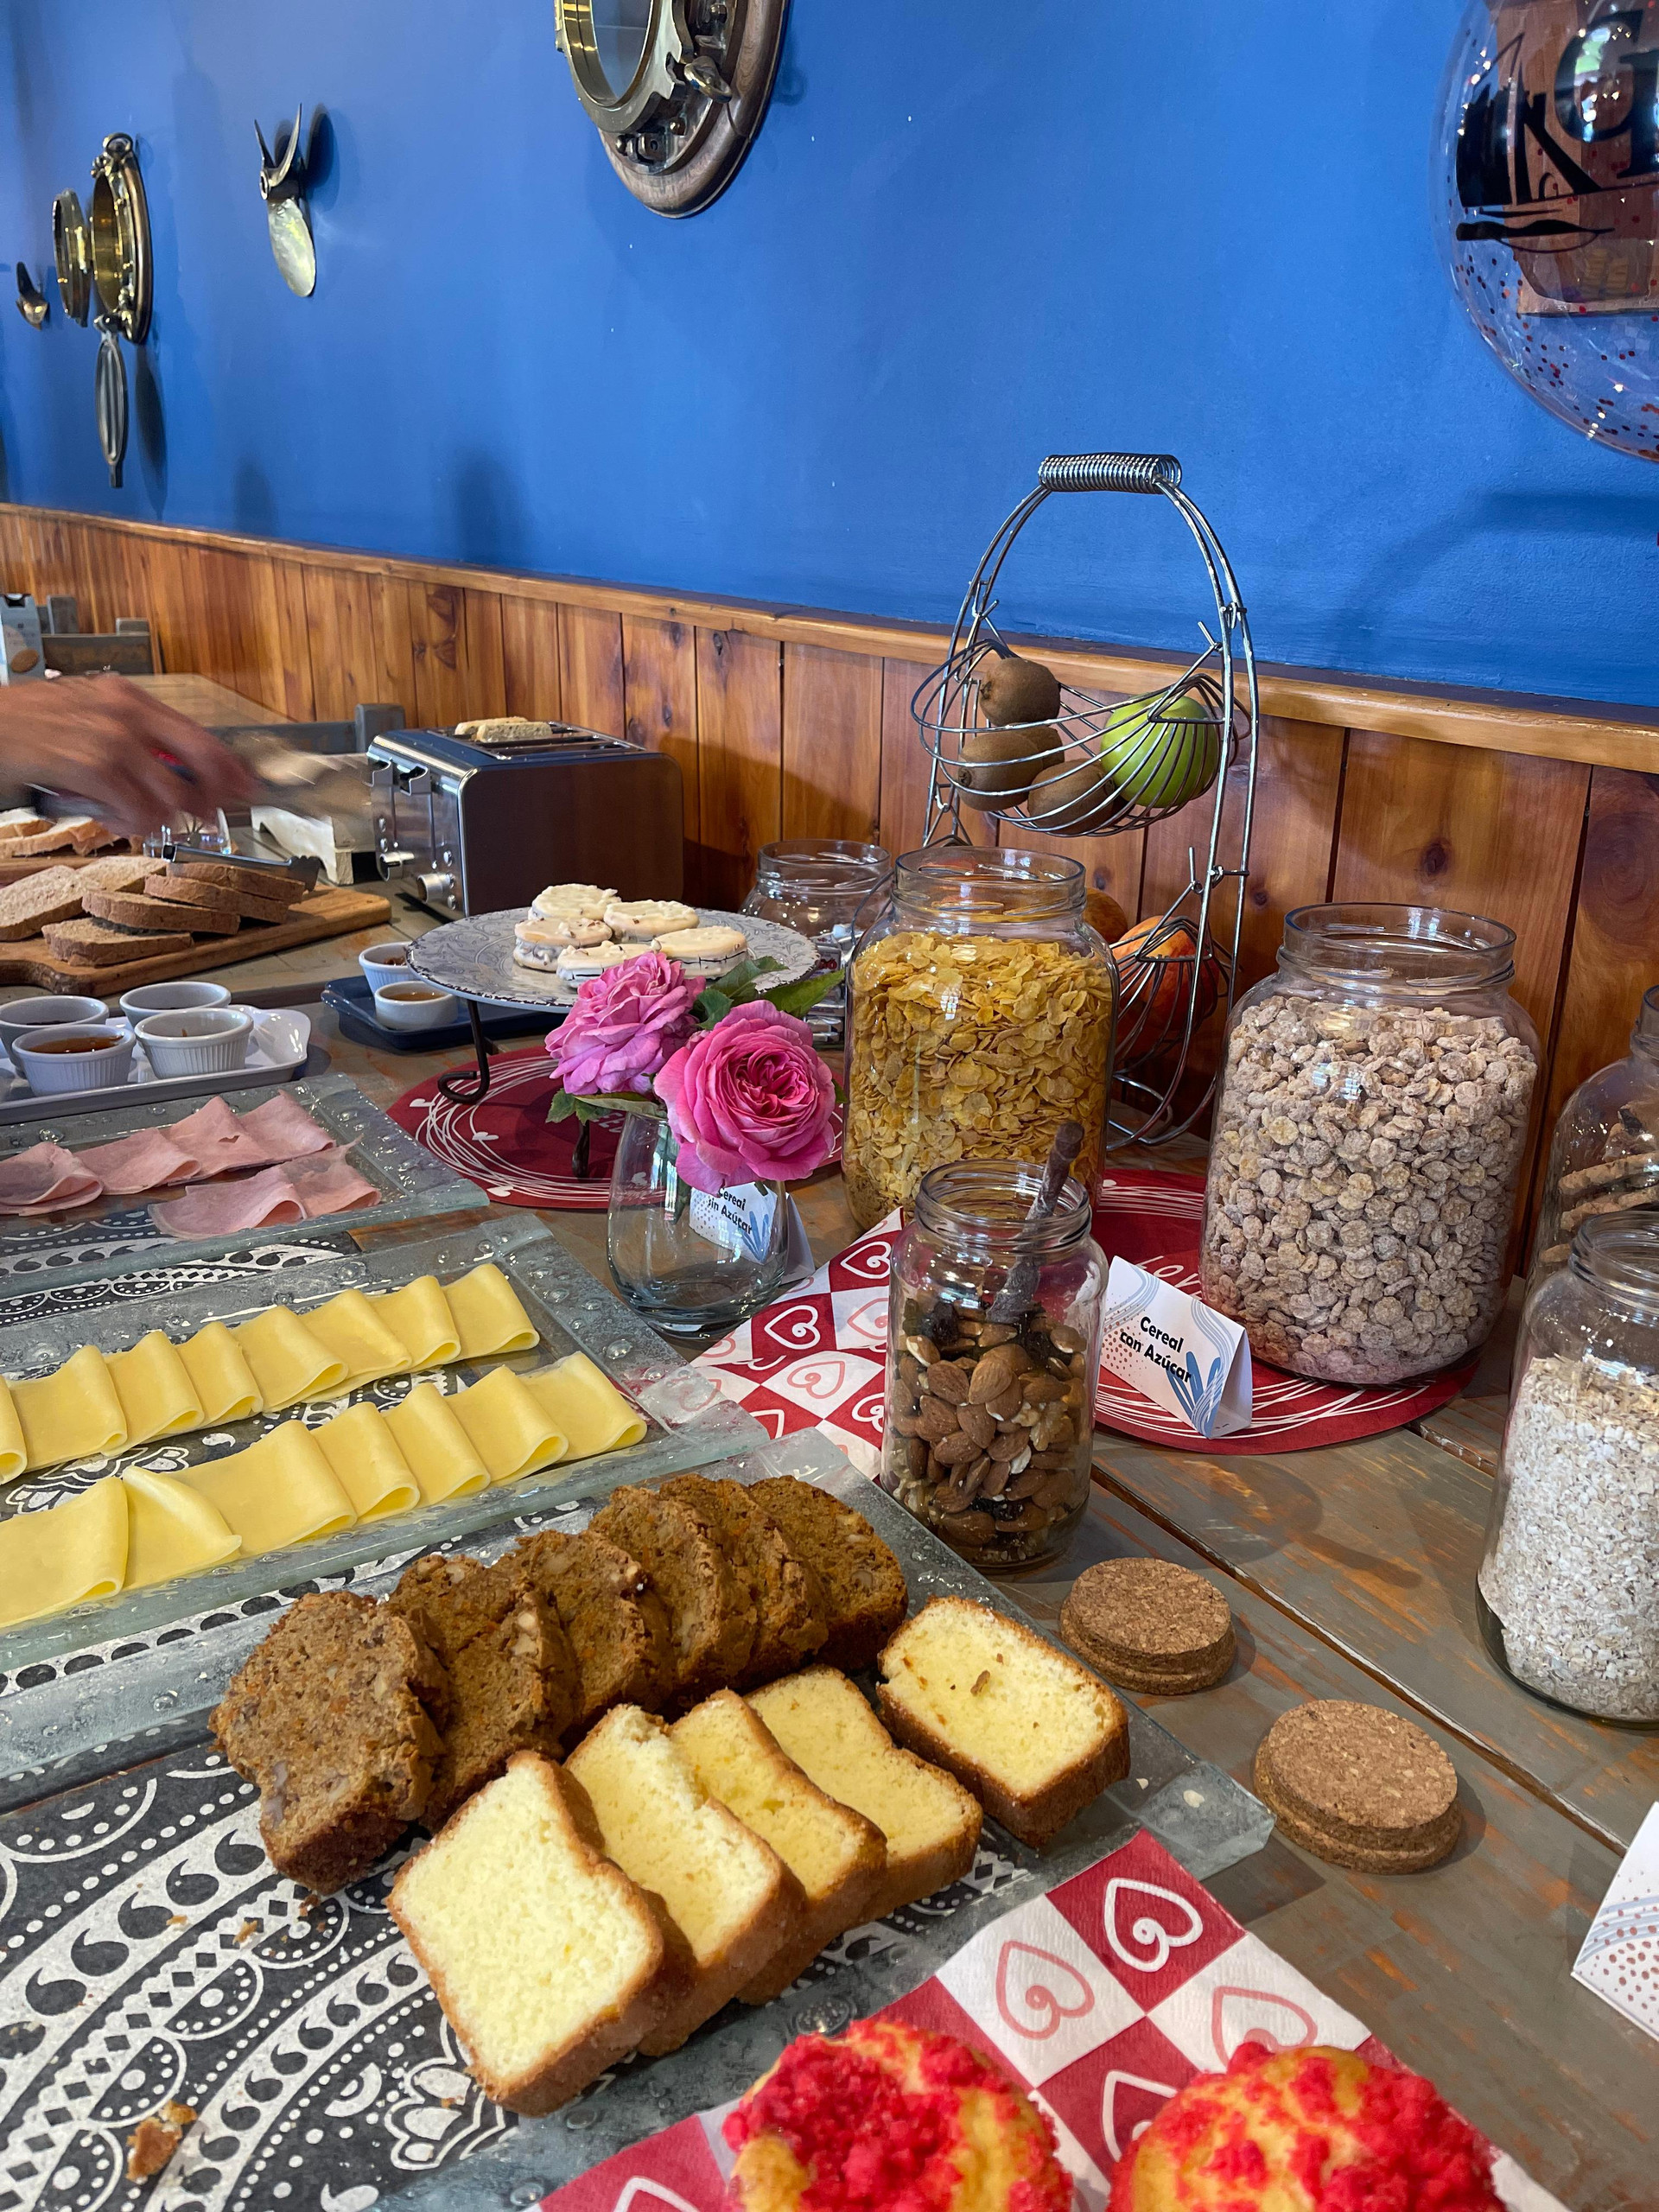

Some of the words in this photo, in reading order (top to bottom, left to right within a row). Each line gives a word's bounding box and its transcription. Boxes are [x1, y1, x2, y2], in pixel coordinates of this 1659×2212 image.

[708, 1198, 719, 1211] sin
[721, 1205, 753, 1234] Azúcar
[718, 1187, 747, 1211] Cereal
[1140, 1316, 1185, 1353] Cereal
[1120, 1332, 1142, 1353] con
[1144, 1344, 1192, 1382] Azúcar
